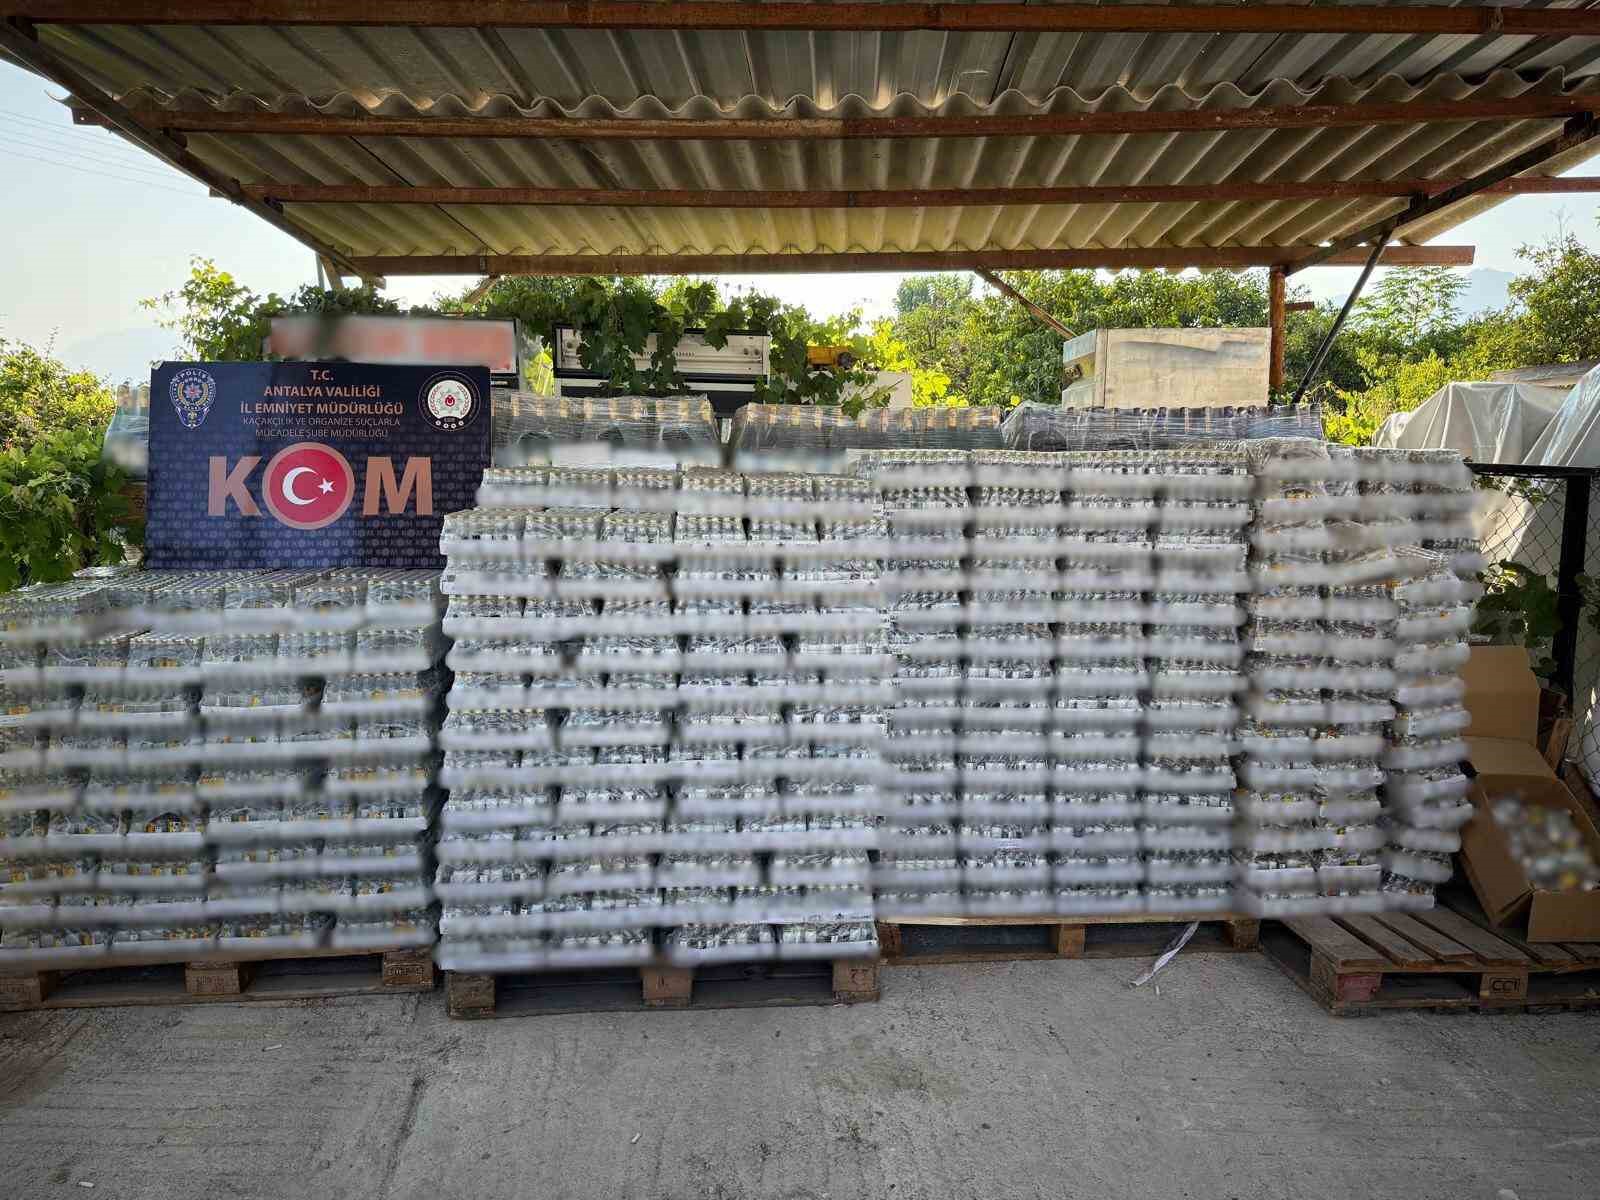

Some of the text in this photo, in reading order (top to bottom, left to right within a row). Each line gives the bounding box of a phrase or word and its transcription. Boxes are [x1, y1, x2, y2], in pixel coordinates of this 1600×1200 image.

[310, 369, 334, 381] T.C.
[263, 384, 380, 398] ANTALYA VALİLİĞİ
[240, 400, 404, 414] İL EMNİYET MÜDÜRLÜĞÜ
[296, 417, 306, 426] VE
[356, 417, 400, 427] SUÇLARLA
[208, 442, 433, 530] KOM
